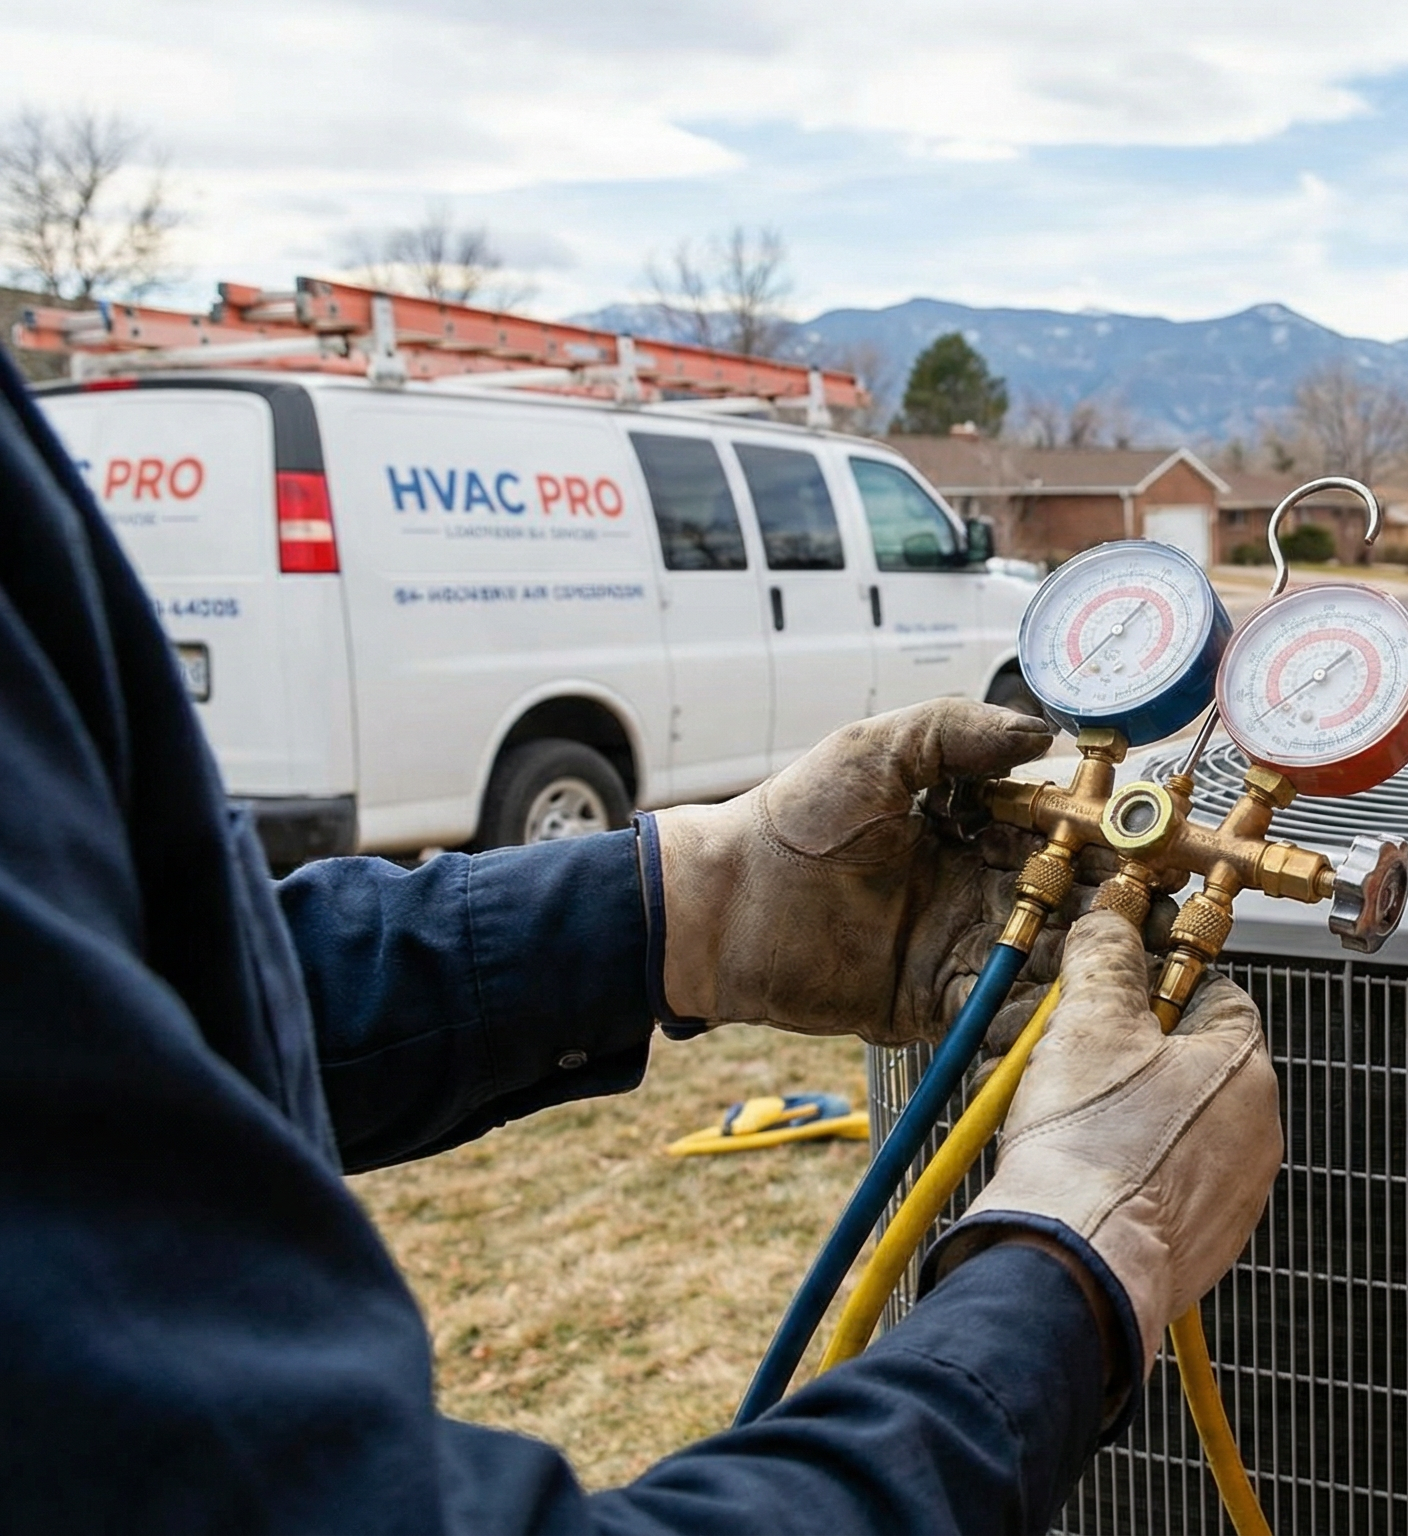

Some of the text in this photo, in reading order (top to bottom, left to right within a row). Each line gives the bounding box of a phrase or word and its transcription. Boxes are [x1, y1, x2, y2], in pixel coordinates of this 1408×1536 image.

[103, 456, 205, 501] PRO
[386, 464, 625, 519] HVAC PRO
